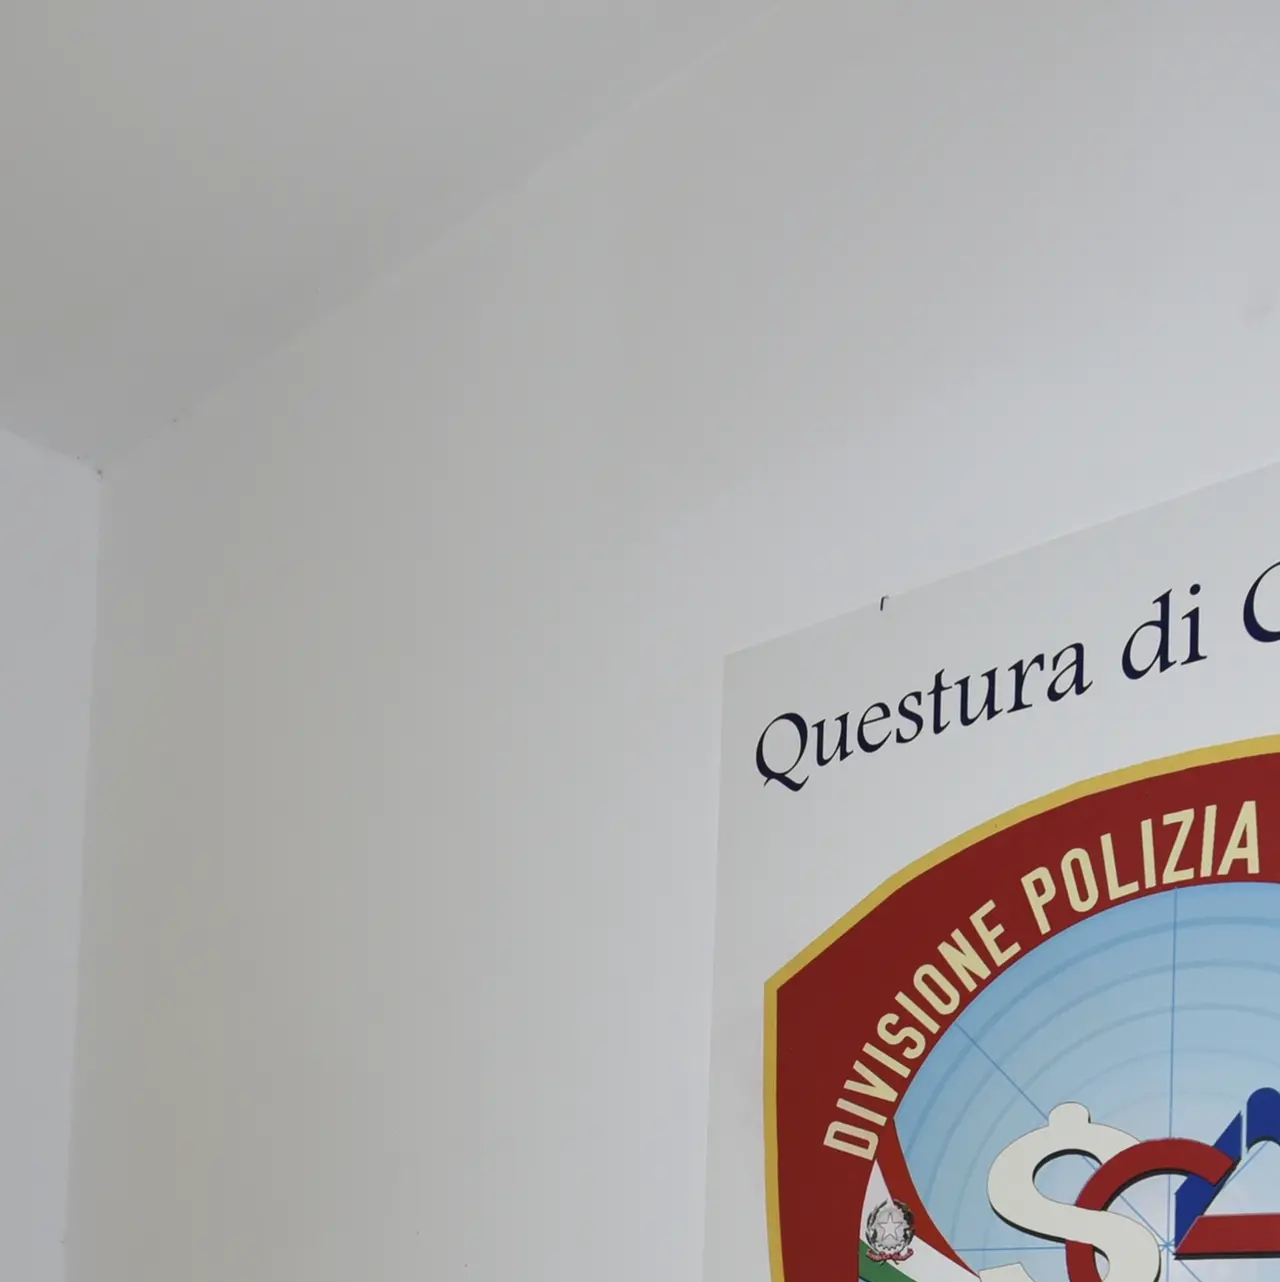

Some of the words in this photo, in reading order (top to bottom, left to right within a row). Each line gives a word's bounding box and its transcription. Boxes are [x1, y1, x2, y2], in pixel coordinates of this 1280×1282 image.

[754, 640, 1094, 793] Questura
[1121, 583, 1208, 680] di
[823, 899, 1021, 1161] DIVISIONE
[1020, 800, 1261, 935] POLIZIA
